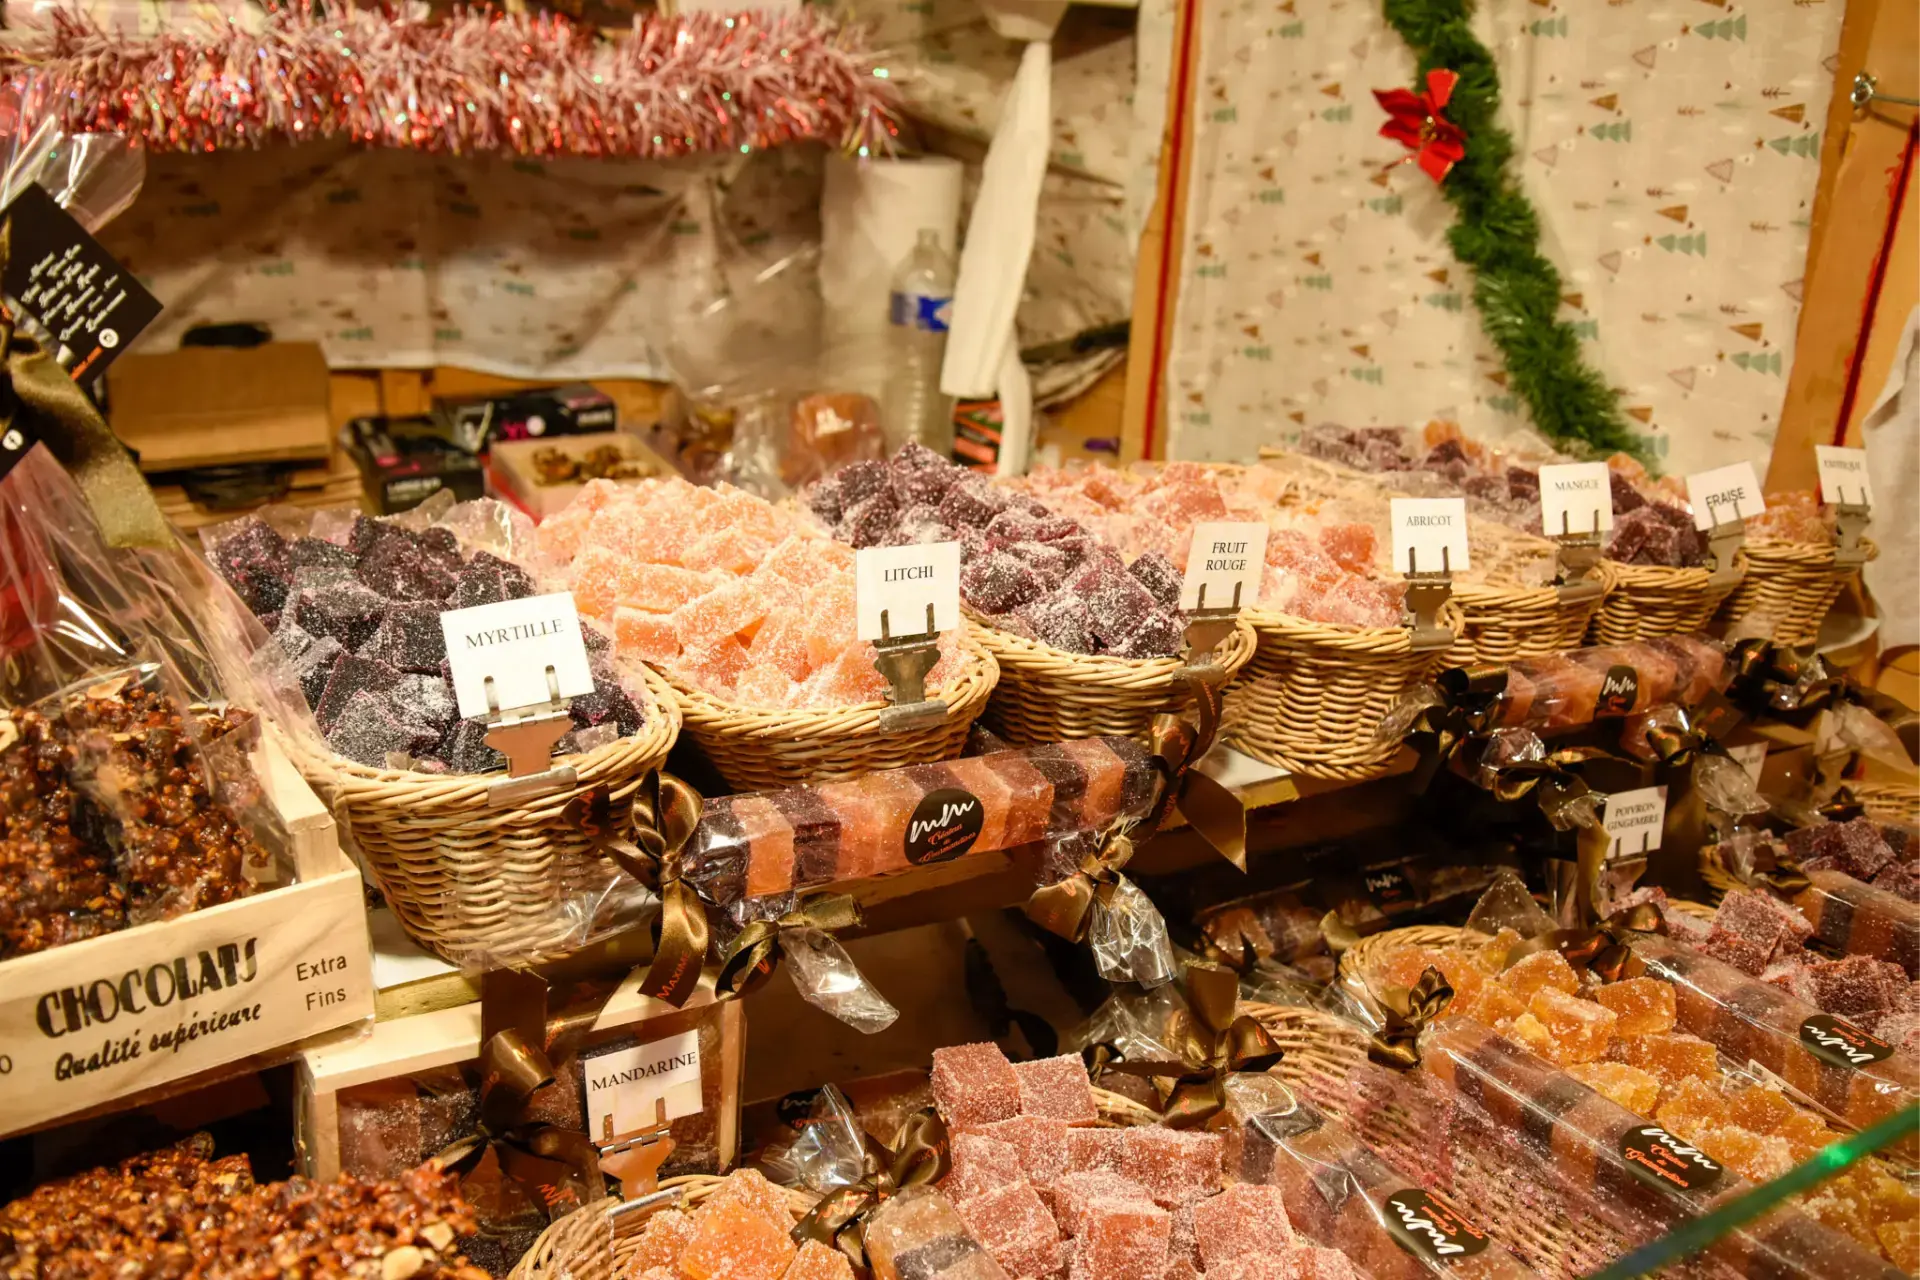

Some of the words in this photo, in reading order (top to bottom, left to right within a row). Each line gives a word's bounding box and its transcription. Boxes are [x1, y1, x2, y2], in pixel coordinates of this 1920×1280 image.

[1555, 480, 1600, 491] MANGUE
[1705, 487, 1746, 508] FRAISE
[1406, 515, 1452, 527] ABRICOT
[1212, 542, 1248, 554] FRUIT
[884, 565, 934, 582] LITCHI
[1206, 559, 1247, 571] ROUGE
[464, 618, 564, 649] MYRTILLE
[1615, 803, 1656, 817] POIVRON
[1606, 813, 1660, 831] GINGEMBRE
[297, 955, 347, 982] Extra
[35, 937, 258, 1038] CHOCOLATS
[306, 987, 347, 1011] Fins
[55, 1029, 141, 1082] Qualité
[148, 1003, 262, 1054] supérieure
[591, 1052, 697, 1092] MANDARINE
